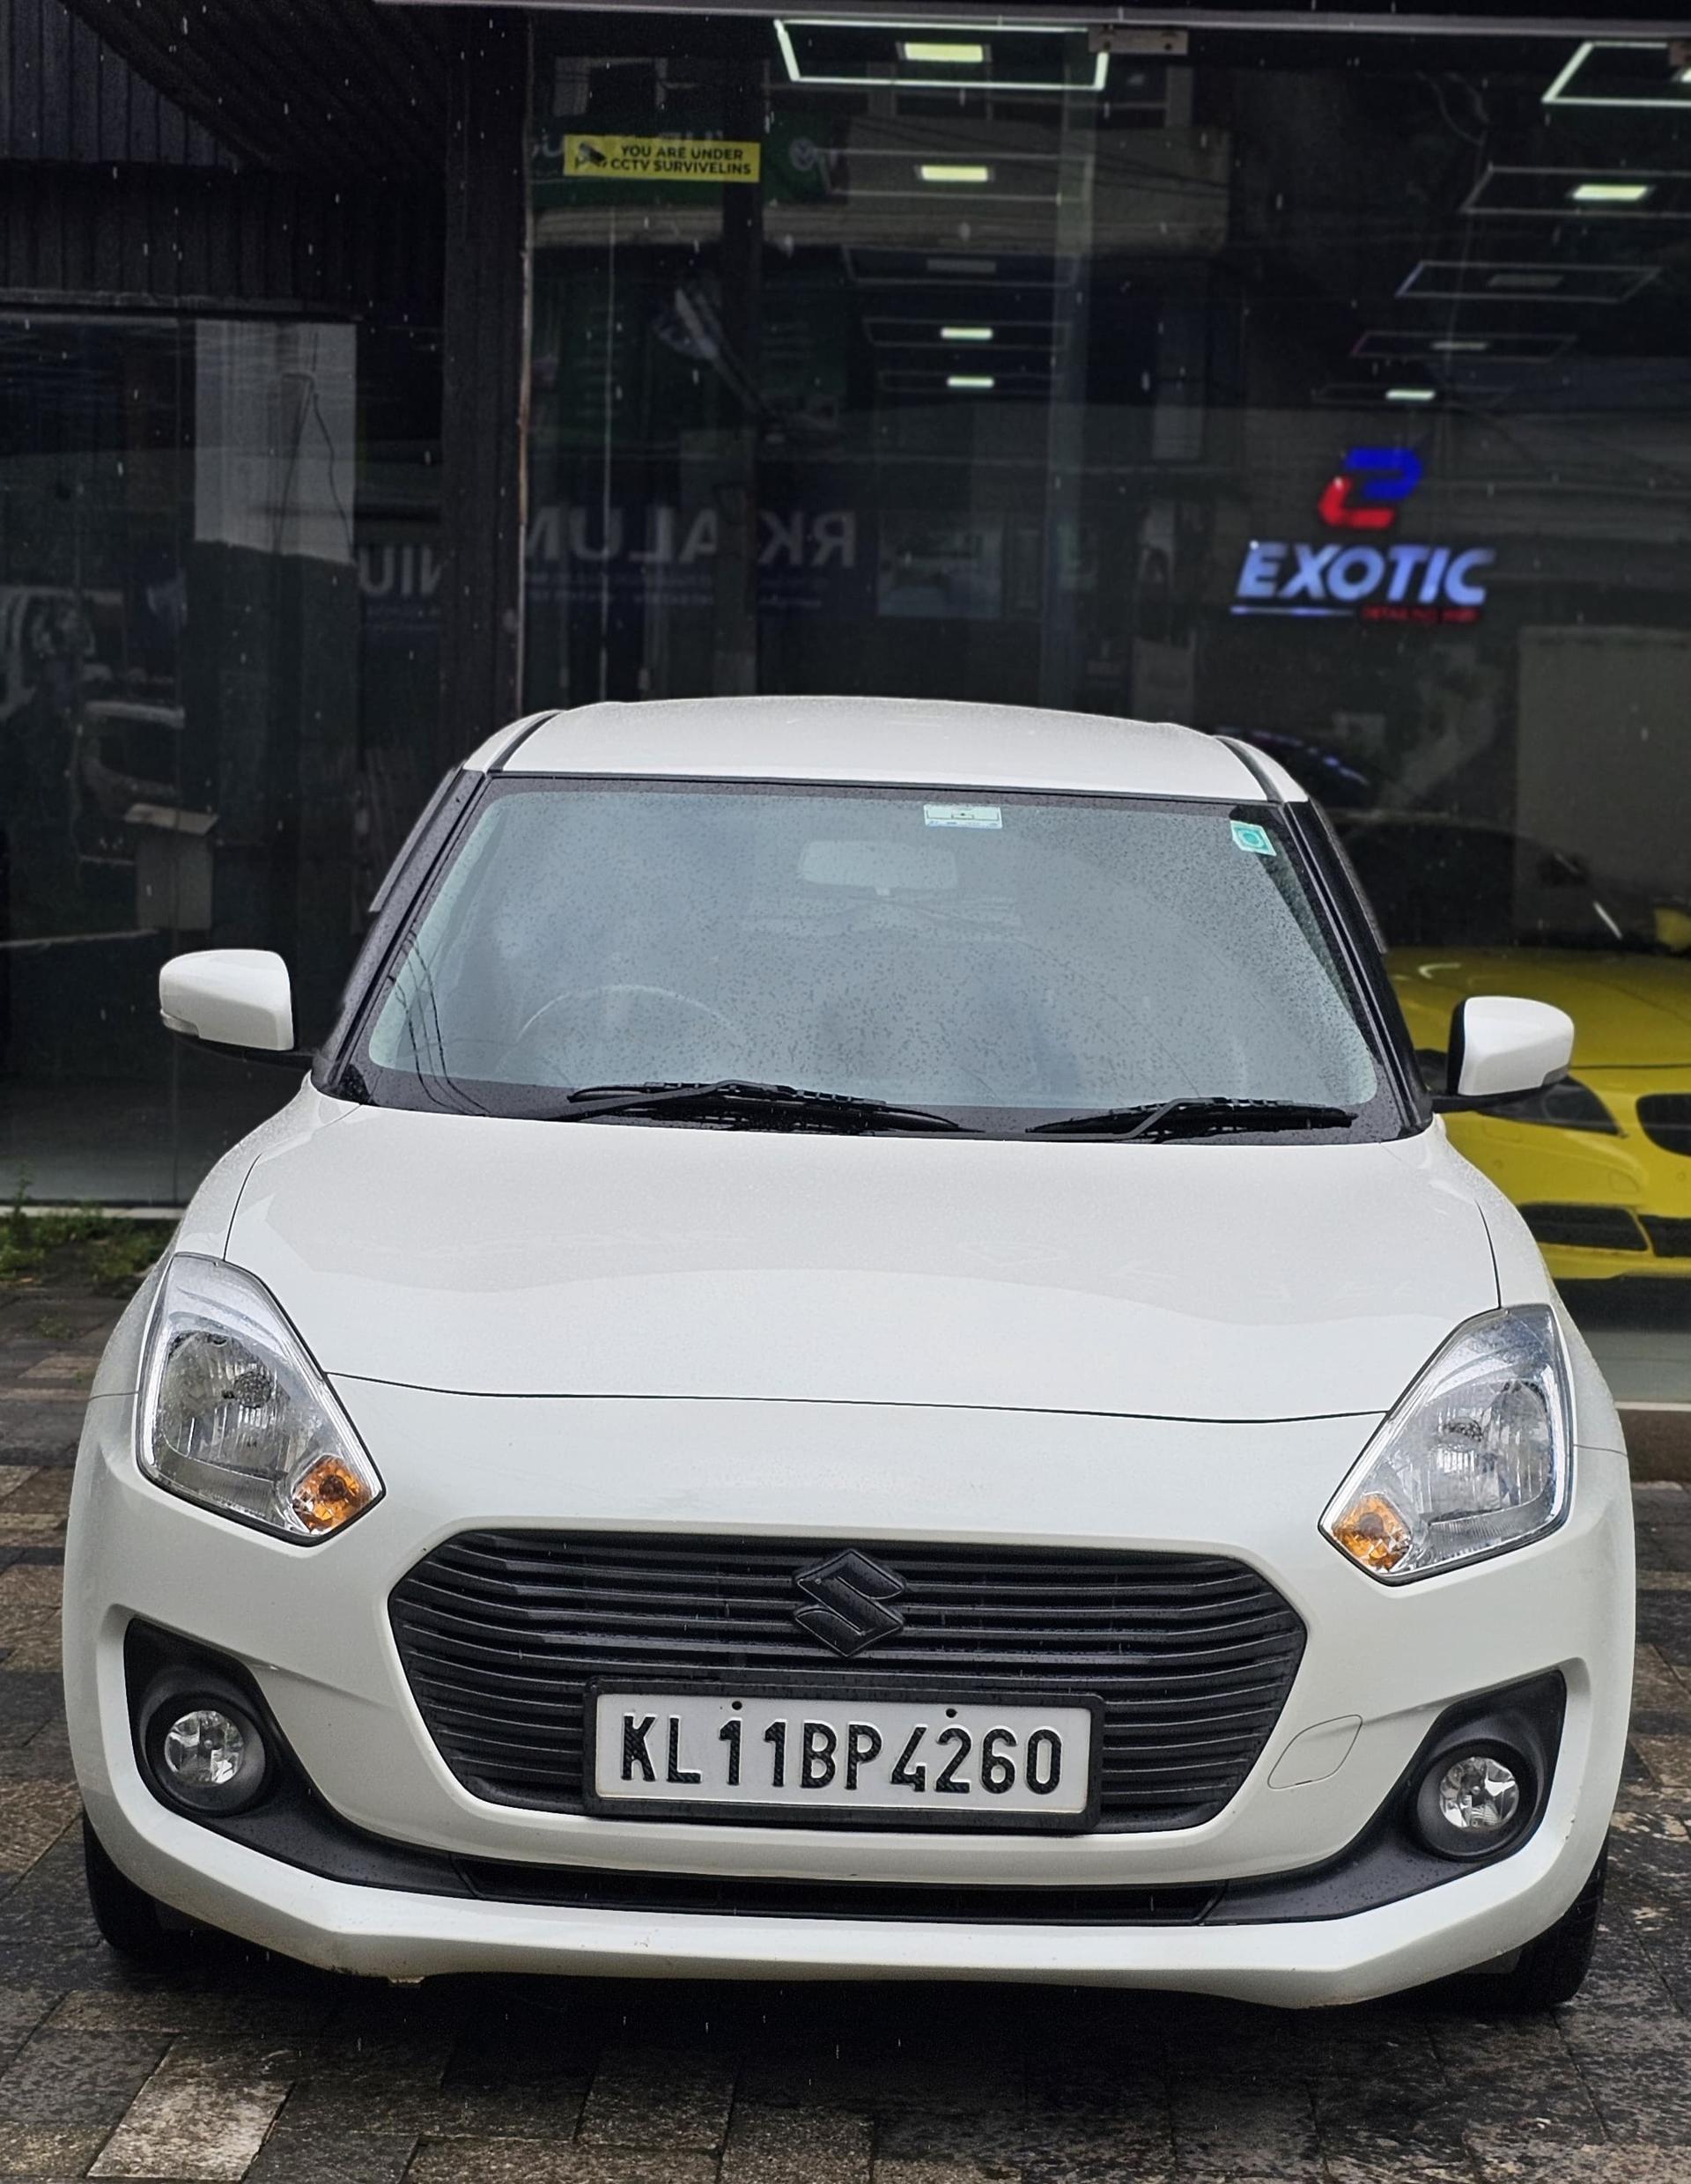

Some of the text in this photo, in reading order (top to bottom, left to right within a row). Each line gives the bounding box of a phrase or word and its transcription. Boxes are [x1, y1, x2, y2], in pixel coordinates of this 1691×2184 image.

[621, 144, 743, 160] YOU ARE UNDER
[610, 159, 650, 171] CCTV
[1236, 542, 1495, 606] EXOTIC
